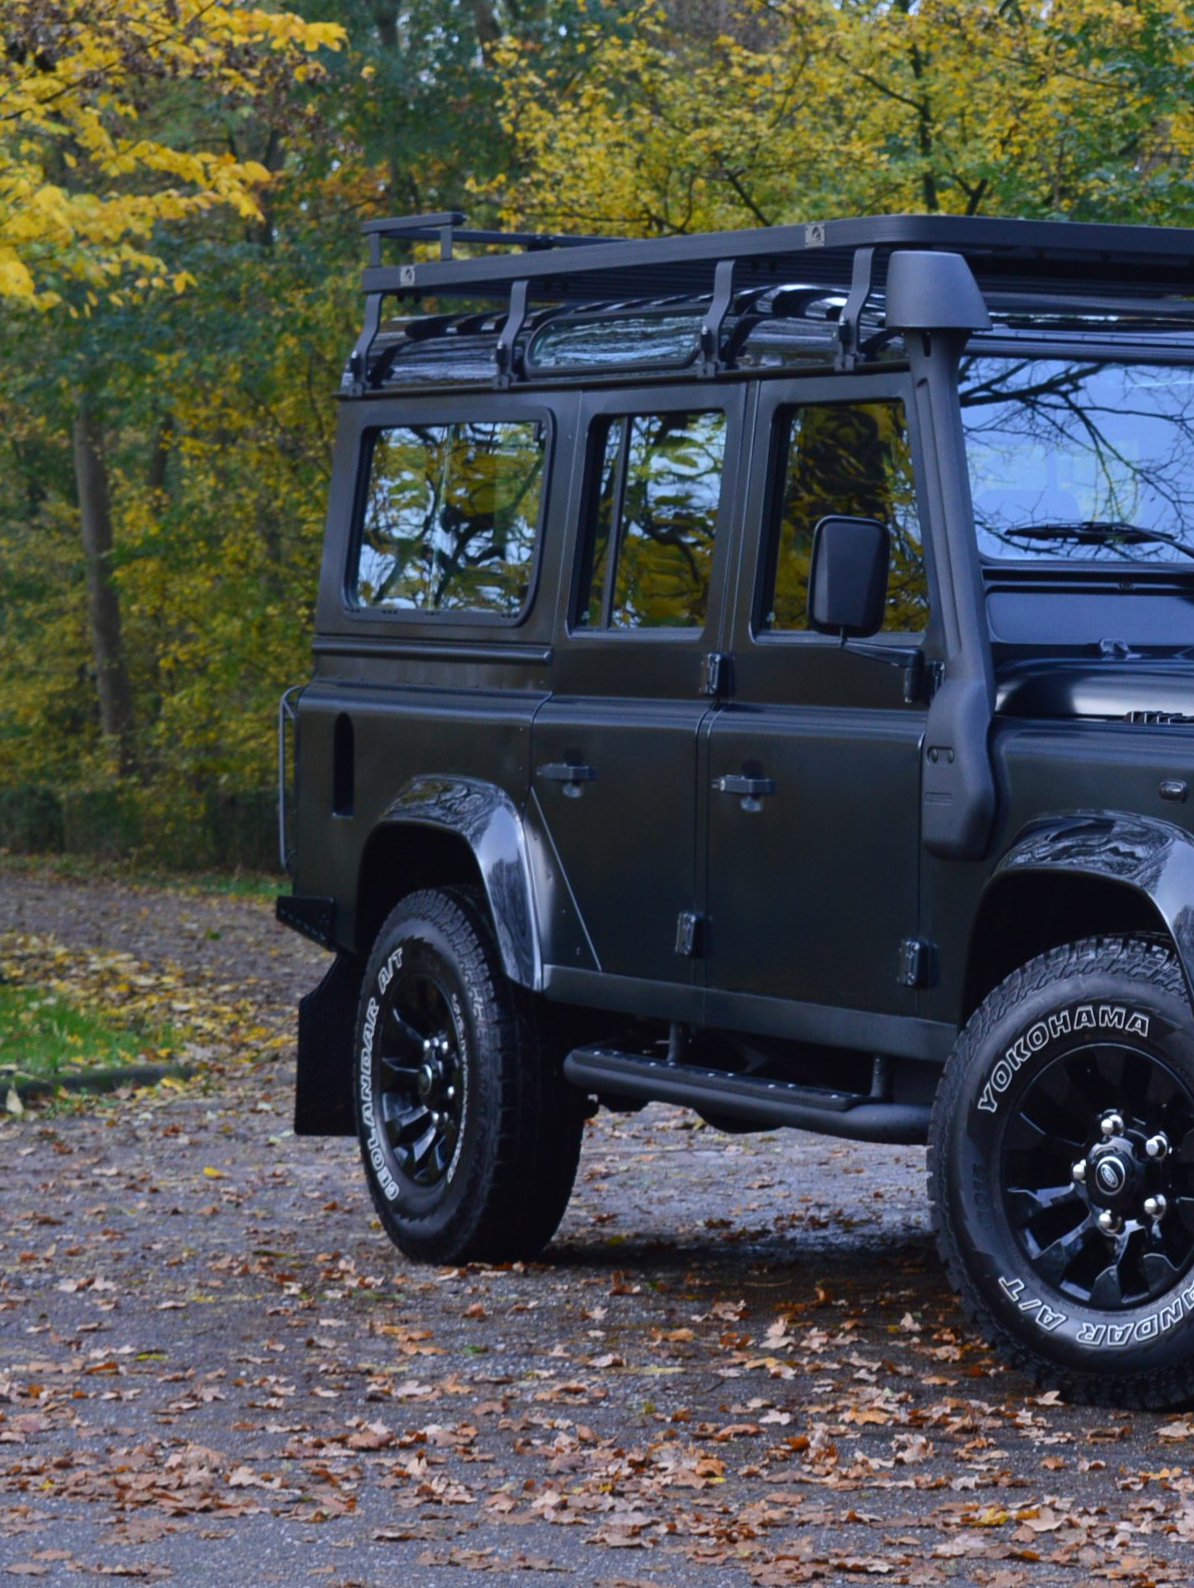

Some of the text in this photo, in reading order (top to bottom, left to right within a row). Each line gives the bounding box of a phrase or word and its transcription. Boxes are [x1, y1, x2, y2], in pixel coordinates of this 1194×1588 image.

[360, 948, 404, 1201] GEOLANDAR A/T
[977, 1004, 1150, 1114] YOKOHAMA
[998, 1276, 1067, 1331] A/T
